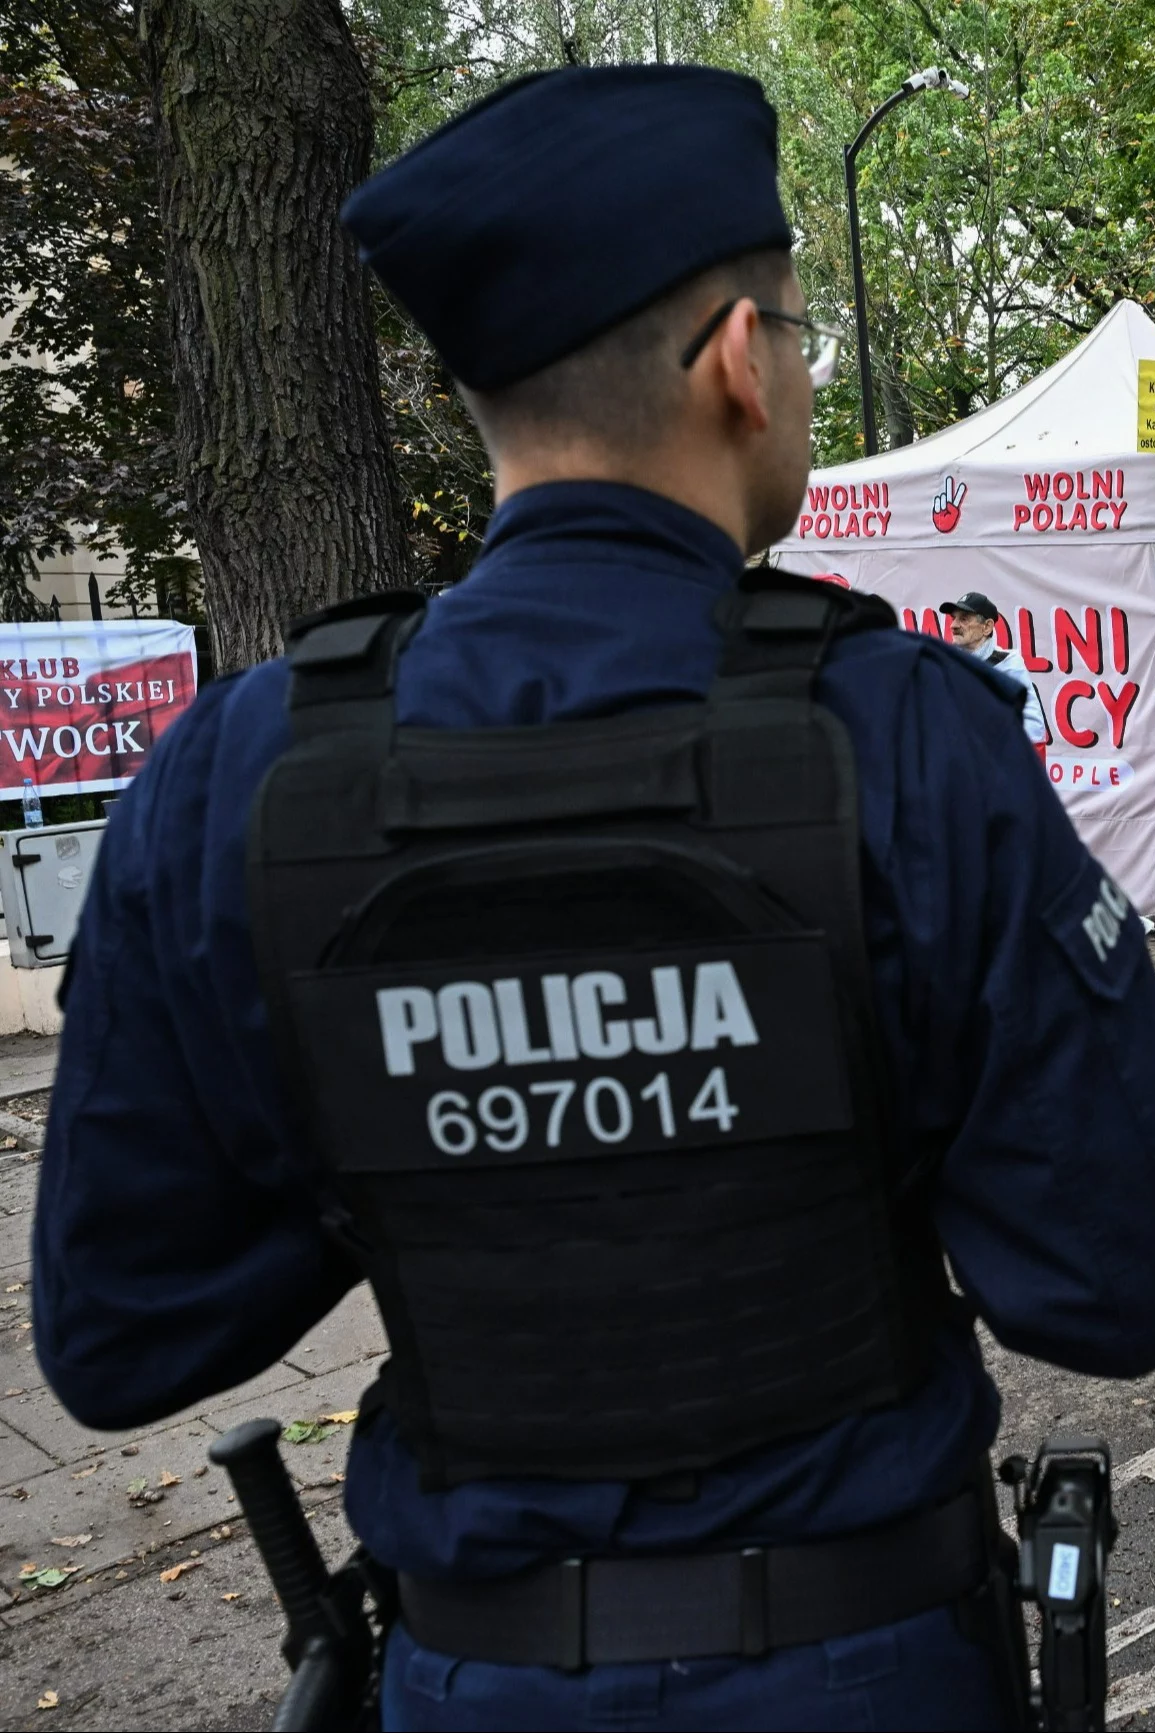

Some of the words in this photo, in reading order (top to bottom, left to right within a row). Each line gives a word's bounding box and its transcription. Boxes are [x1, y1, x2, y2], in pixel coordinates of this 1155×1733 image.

[807, 482, 890, 512] WOLNI
[1023, 469, 1125, 502] WOLNI
[799, 510, 892, 540] POLACY
[1013, 500, 1128, 532] POLACY
[0, 657, 80, 681] KLUB
[36, 680, 175, 707] POLSKIEJ
[0, 721, 145, 762] WOCK
[1050, 763, 1121, 785] OPLE
[376, 960, 760, 1077] POLICJA
[427, 1065, 740, 1156] 697014
